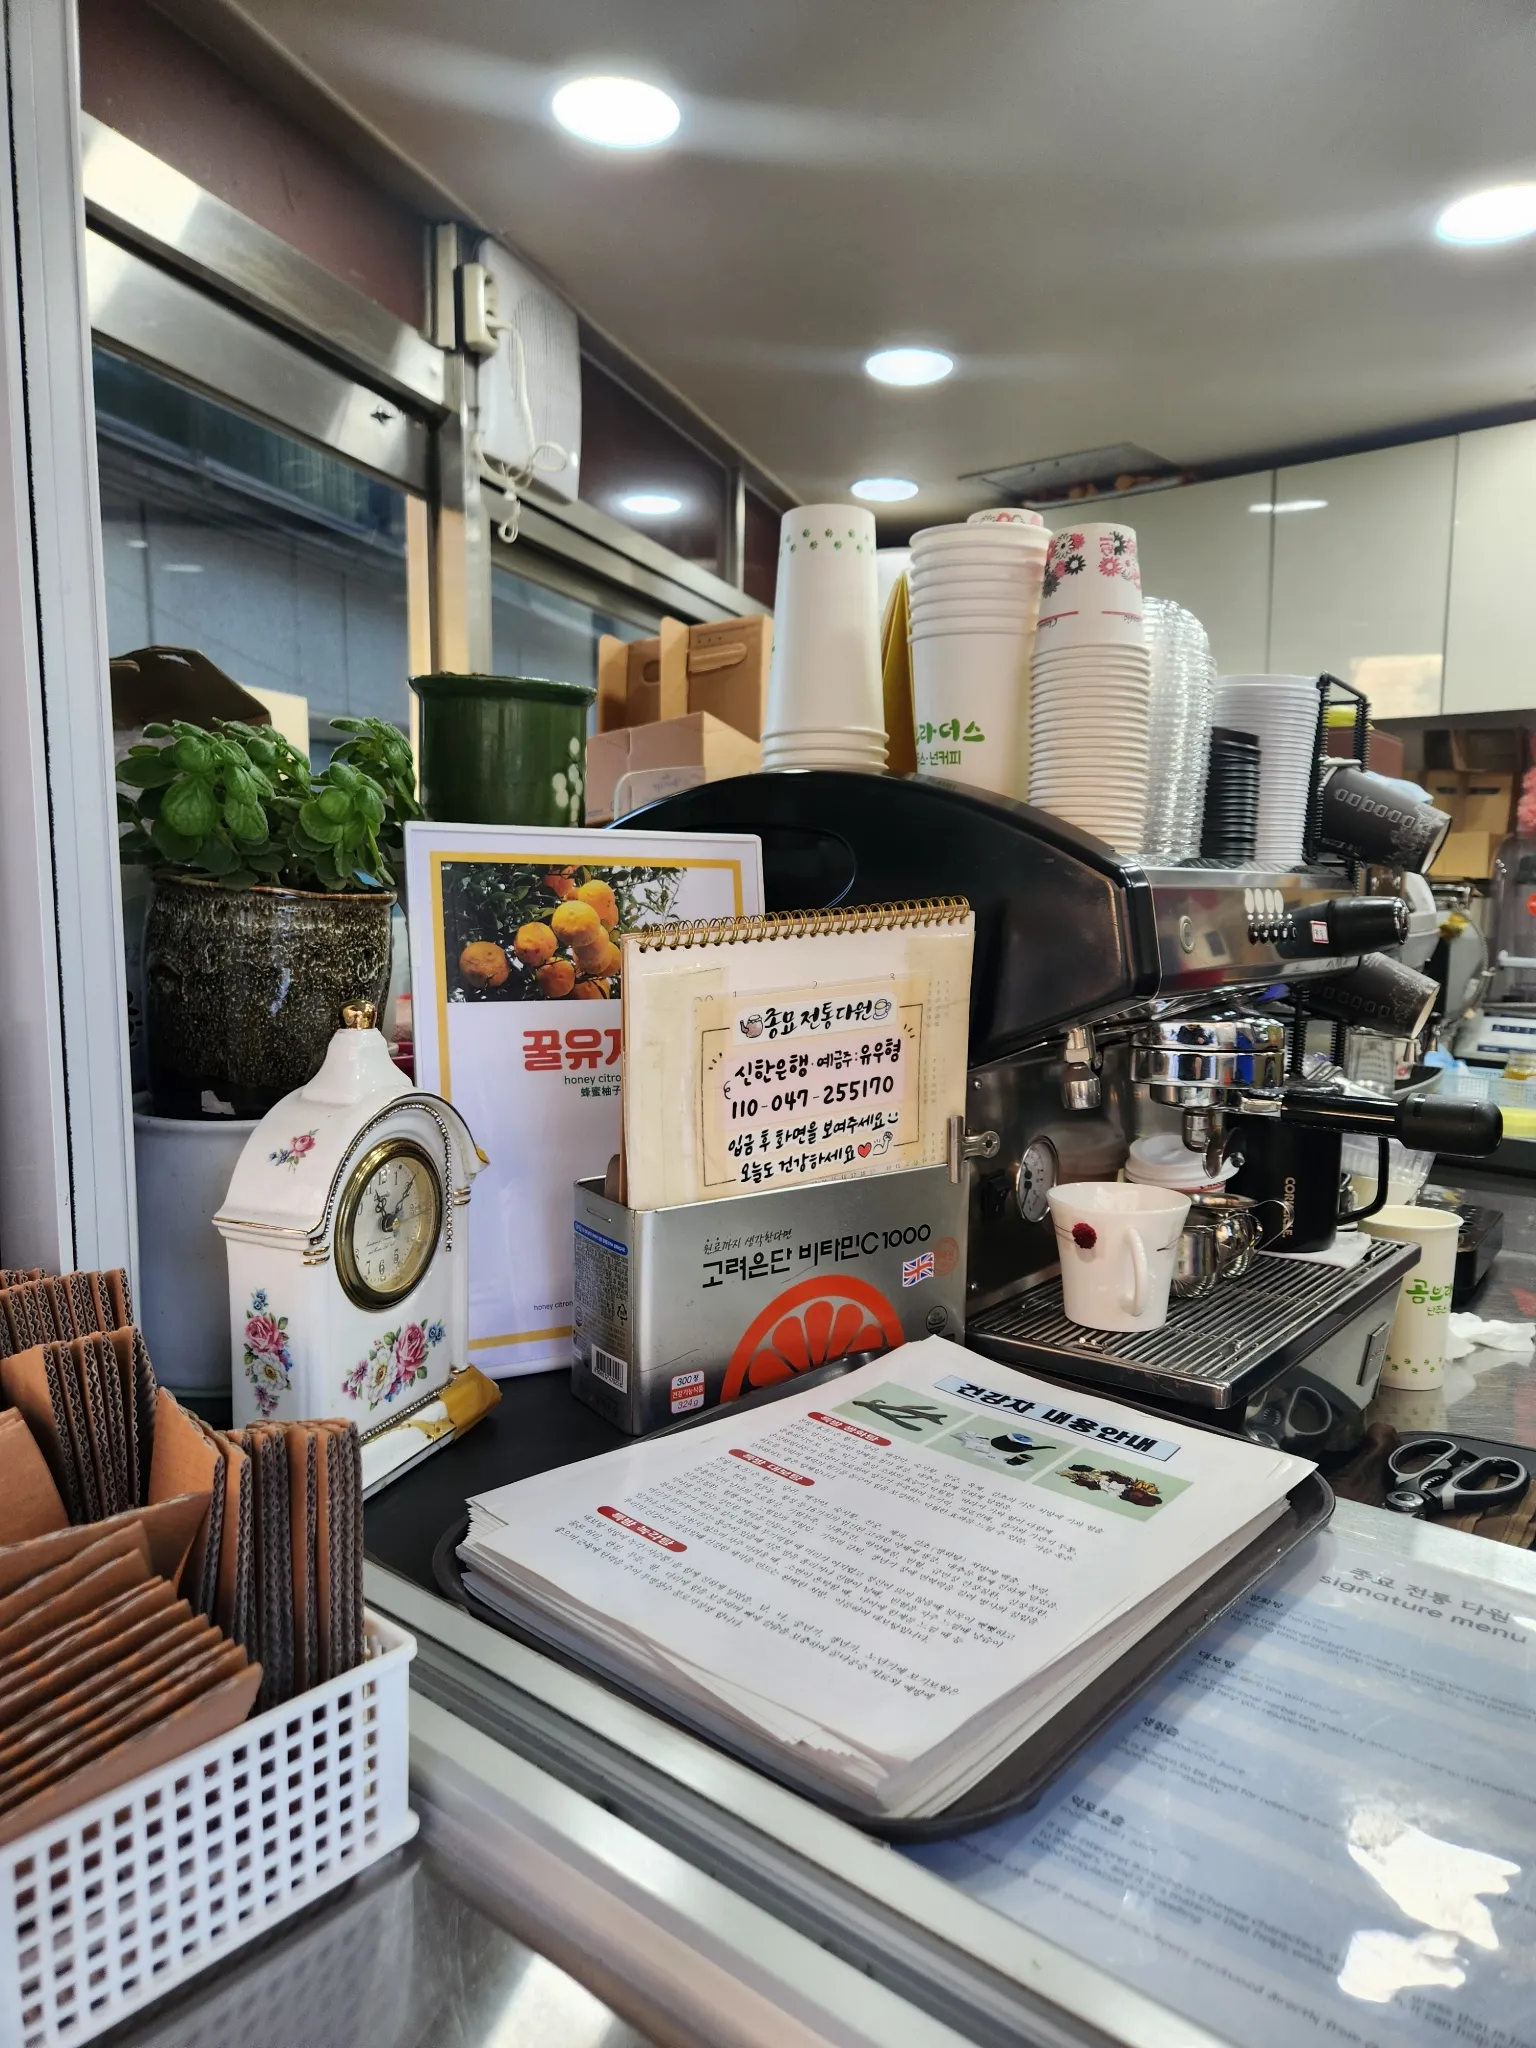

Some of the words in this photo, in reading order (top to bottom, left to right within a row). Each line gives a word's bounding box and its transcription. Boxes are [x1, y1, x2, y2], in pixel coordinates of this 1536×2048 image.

[765, 1008, 798, 1039] 종묘
[801, 1001, 833, 1029] 전통
[836, 1000, 873, 1021] 다원
[564, 1075, 596, 1085] honey
[735, 1054, 808, 1087] 신한은행
[732, 1076, 894, 1120] 110-047-255170
[728, 1129, 754, 1157] 입금
[759, 1129, 770, 1152] 후
[776, 1121, 818, 1149] 화면을
[822, 1112, 886, 1140] 보여주세요
[741, 1162, 774, 1184] 오늘도
[779, 1144, 856, 1173] 건강하세요
[702, 1248, 792, 1289] 고려은단
[533, 1301, 554, 1312] honey
[672, 1385, 704, 1399] 건강기능식품
[956, 1383, 1036, 1414] 건강차
[1041, 1409, 1158, 1452] 내용안내
[1320, 1575, 1443, 1618] signature
[1450, 1616, 1527, 1644] menu
[1405, 1584, 1452, 1605] 전통
[1461, 1601, 1510, 1623] 다원
